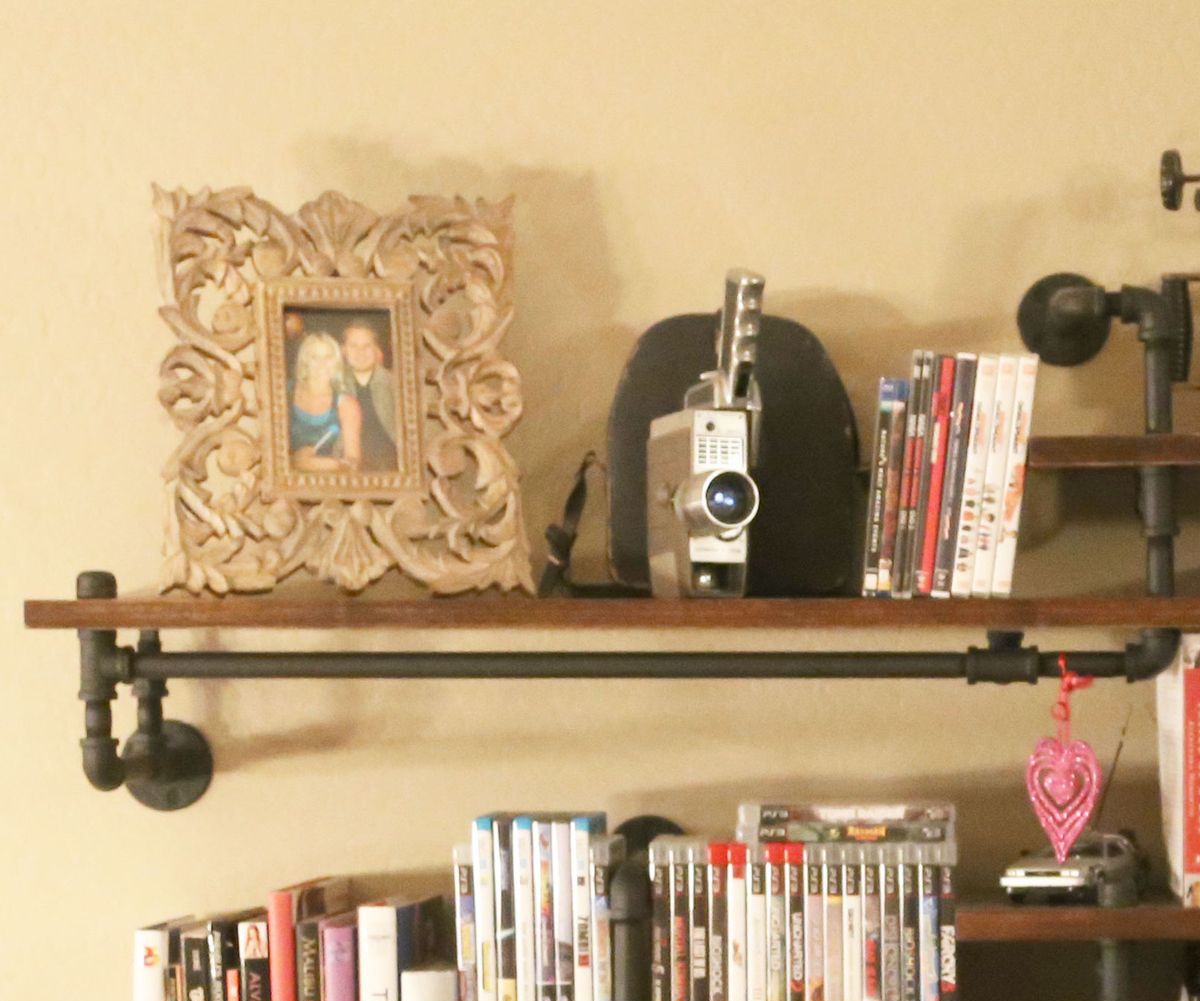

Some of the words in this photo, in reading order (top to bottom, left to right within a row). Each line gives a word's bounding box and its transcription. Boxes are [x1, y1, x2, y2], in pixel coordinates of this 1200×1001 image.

[302, 936, 319, 997] MALIBU
[712, 935, 723, 995] BIOSHOCK
[791, 911, 803, 980] UNCHARTED
